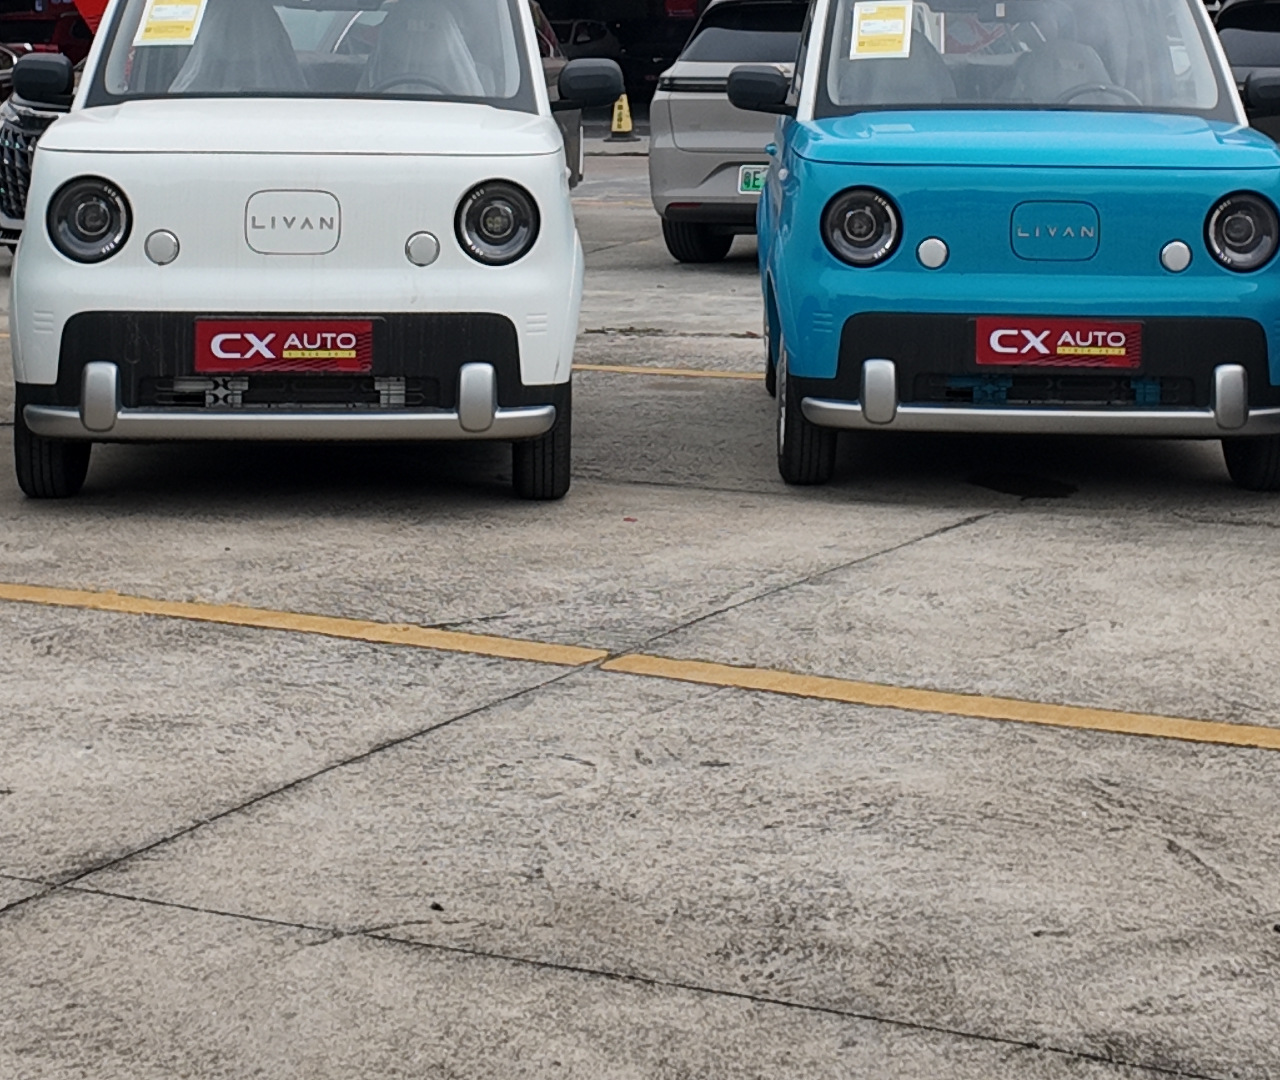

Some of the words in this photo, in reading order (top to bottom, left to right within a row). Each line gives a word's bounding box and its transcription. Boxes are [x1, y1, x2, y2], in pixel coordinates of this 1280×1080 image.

[251, 216, 334, 231] LIVAN
[1017, 226, 1095, 238] LIVAN
[210, 332, 277, 360] CX
[283, 332, 357, 350] AUTO
[989, 329, 1051, 355] CX
[1056, 330, 1126, 347] AUTO
